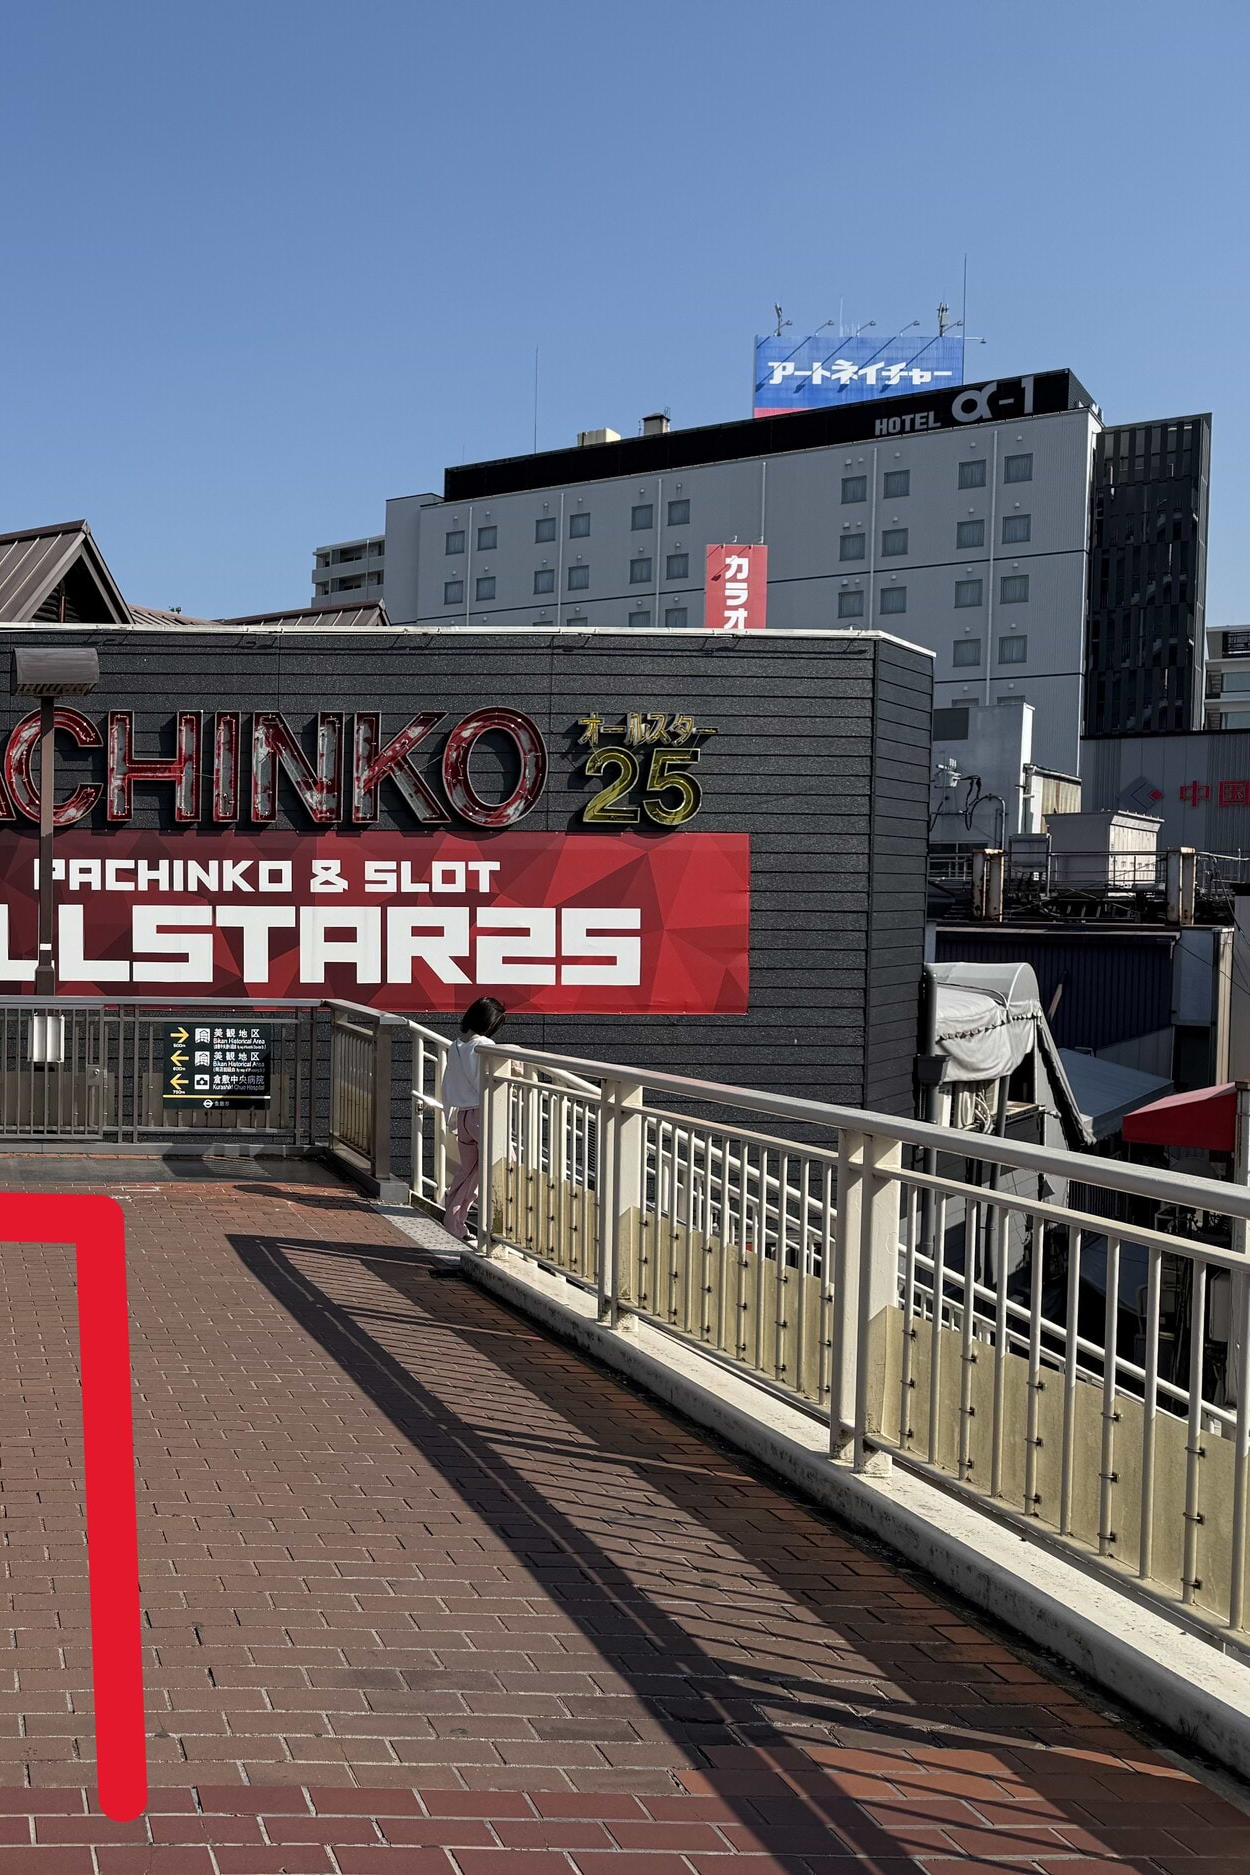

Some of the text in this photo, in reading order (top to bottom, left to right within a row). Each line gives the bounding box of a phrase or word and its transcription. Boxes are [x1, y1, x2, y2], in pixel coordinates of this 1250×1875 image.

[768, 359, 952, 385] アートネイチャー
[874, 411, 942, 436] HOTEL
[577, 712, 719, 746] オールスター
[583, 746, 703, 825] 25
[33, 858, 501, 893] PACHINKO & SLOT
[213, 1028, 260, 1038] 美観地区
[213, 1051, 260, 1061] 美観地区
[213, 1074, 265, 1085] 倉敷中央病院
